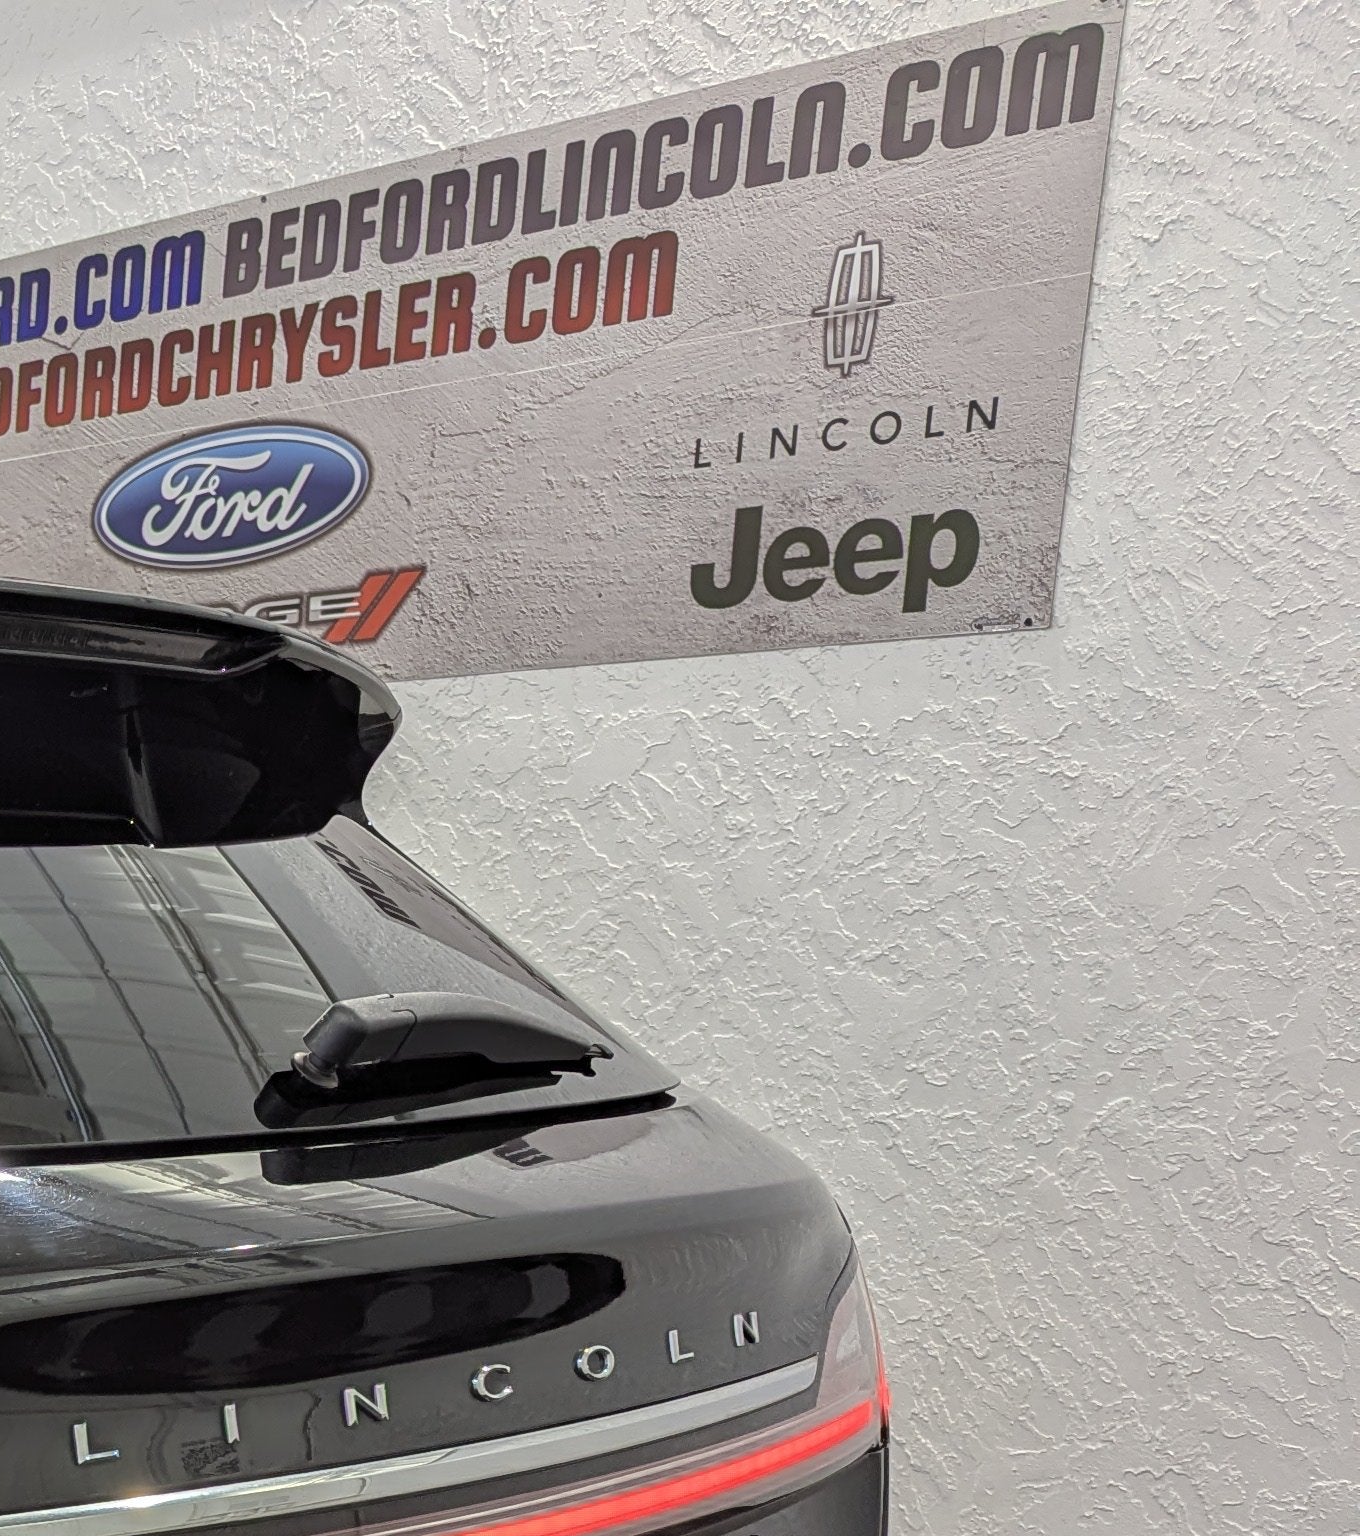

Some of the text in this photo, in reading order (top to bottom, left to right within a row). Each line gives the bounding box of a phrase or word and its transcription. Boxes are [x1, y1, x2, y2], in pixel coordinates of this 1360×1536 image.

[222, 22, 1105, 298] BEDFORDLINCOLN.COM
[693, 396, 1000, 469] LINCOLN
[145, 450, 314, 550] Ford
[690, 505, 980, 613] Jeep
[73, 1310, 762, 1466] LINCOLN
